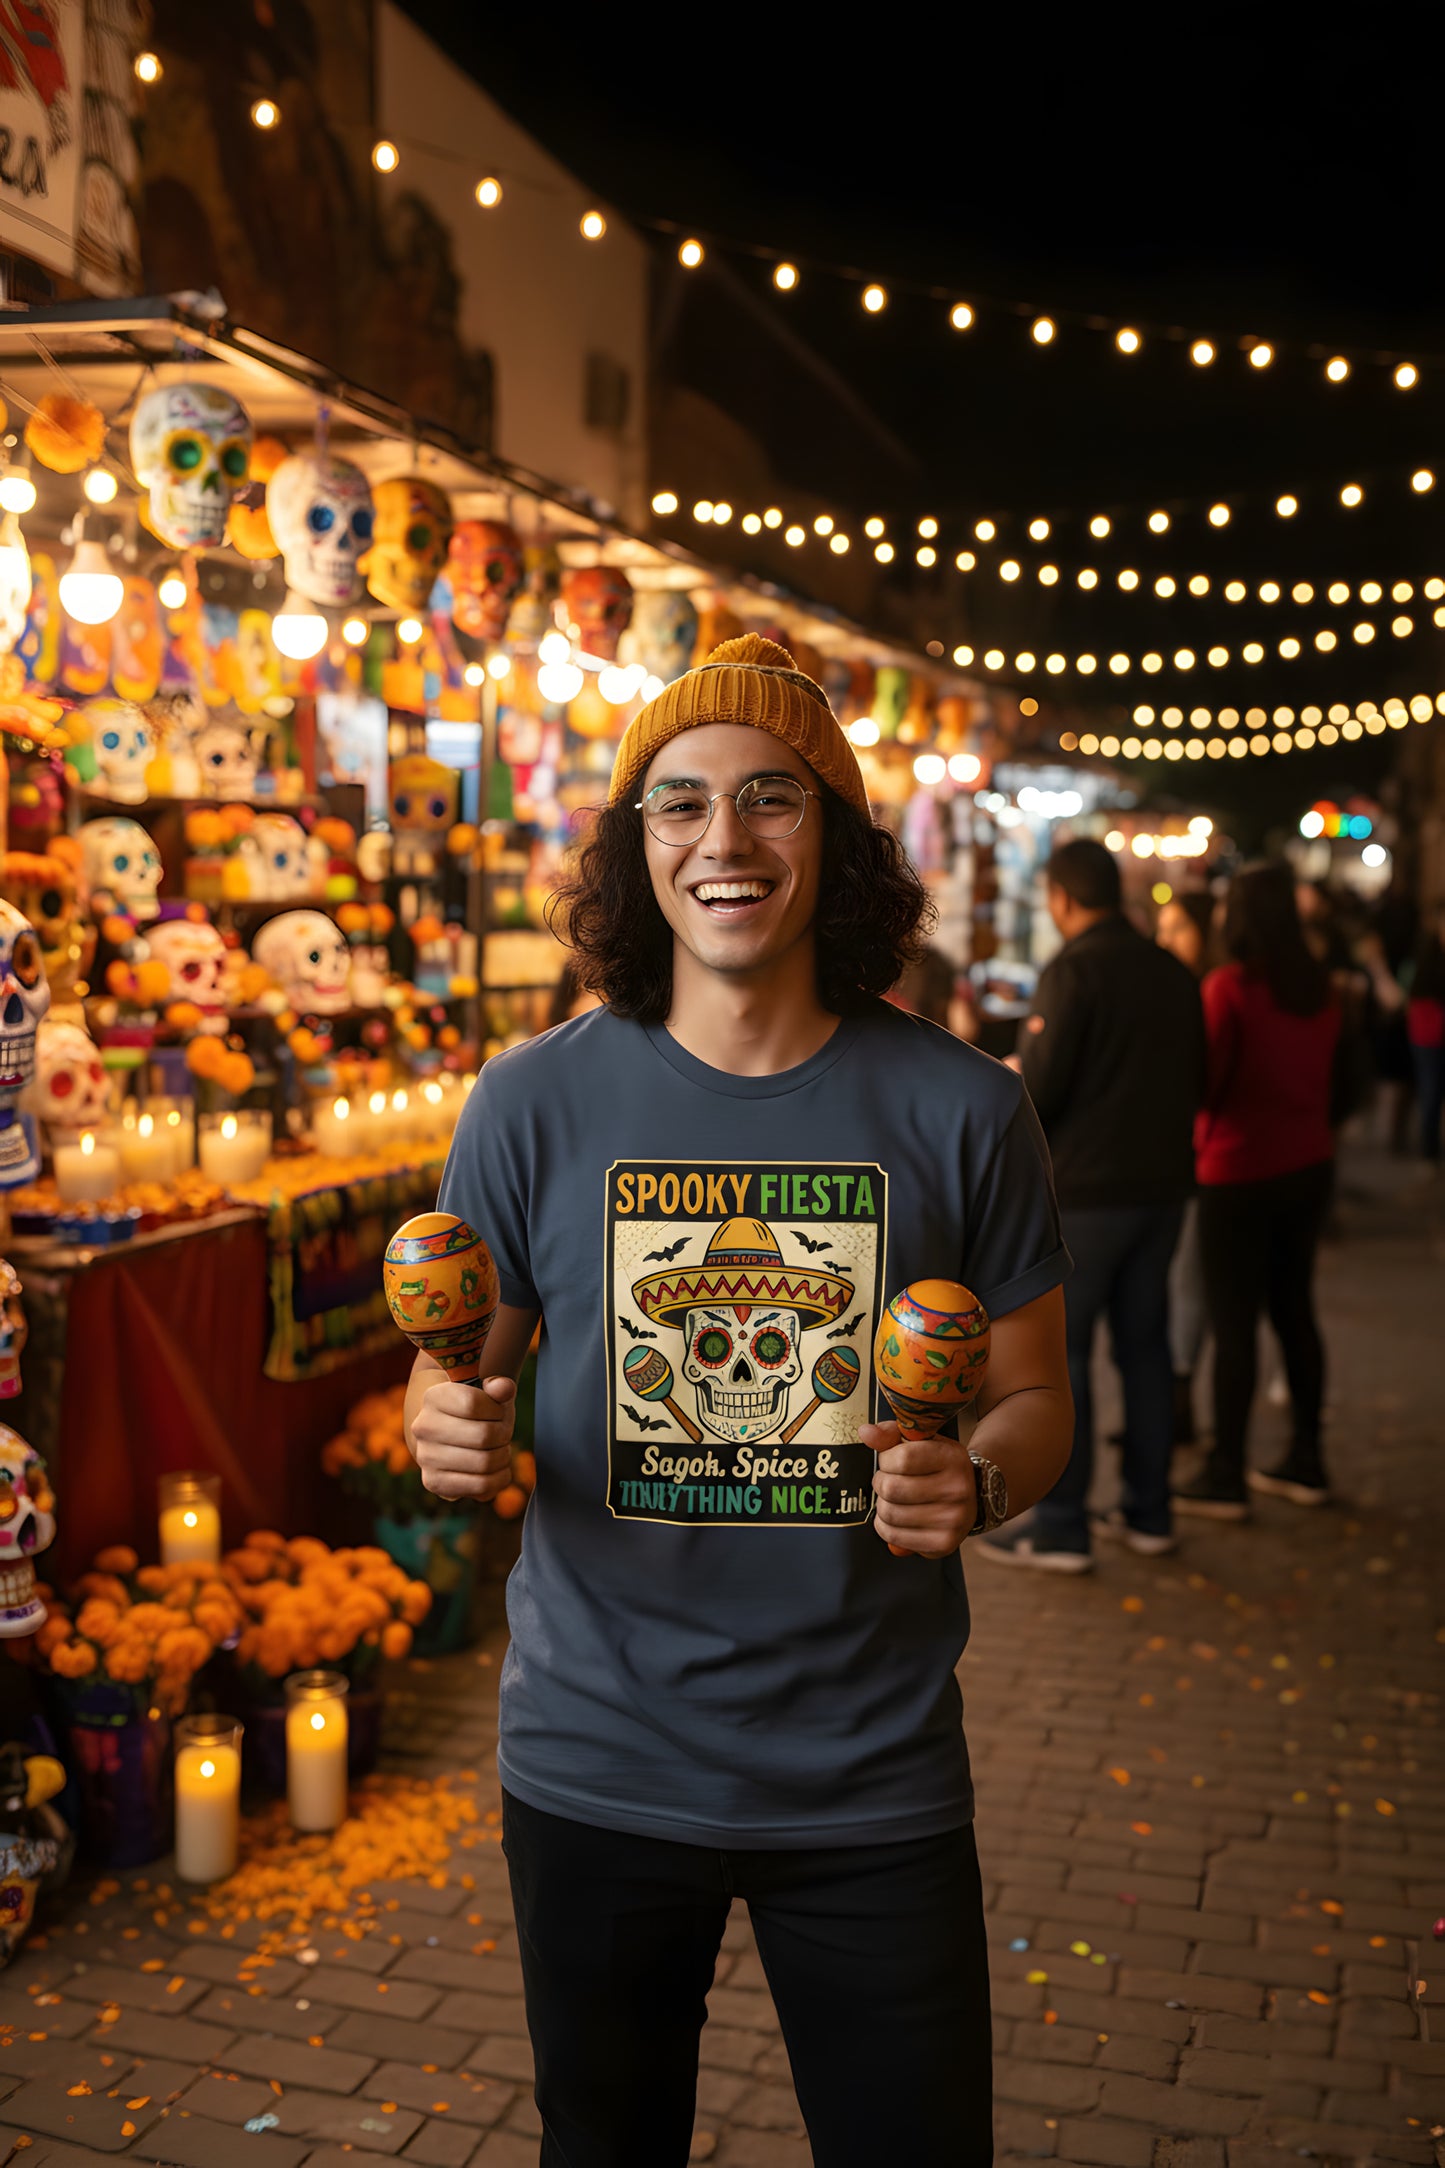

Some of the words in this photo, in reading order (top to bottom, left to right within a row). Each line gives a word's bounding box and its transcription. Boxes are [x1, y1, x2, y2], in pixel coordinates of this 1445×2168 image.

[616, 1172, 752, 1215] SPOOKY
[760, 1174, 875, 1216] FIESTA
[732, 1446, 809, 1485] Spice
[814, 1449, 840, 1479] &
